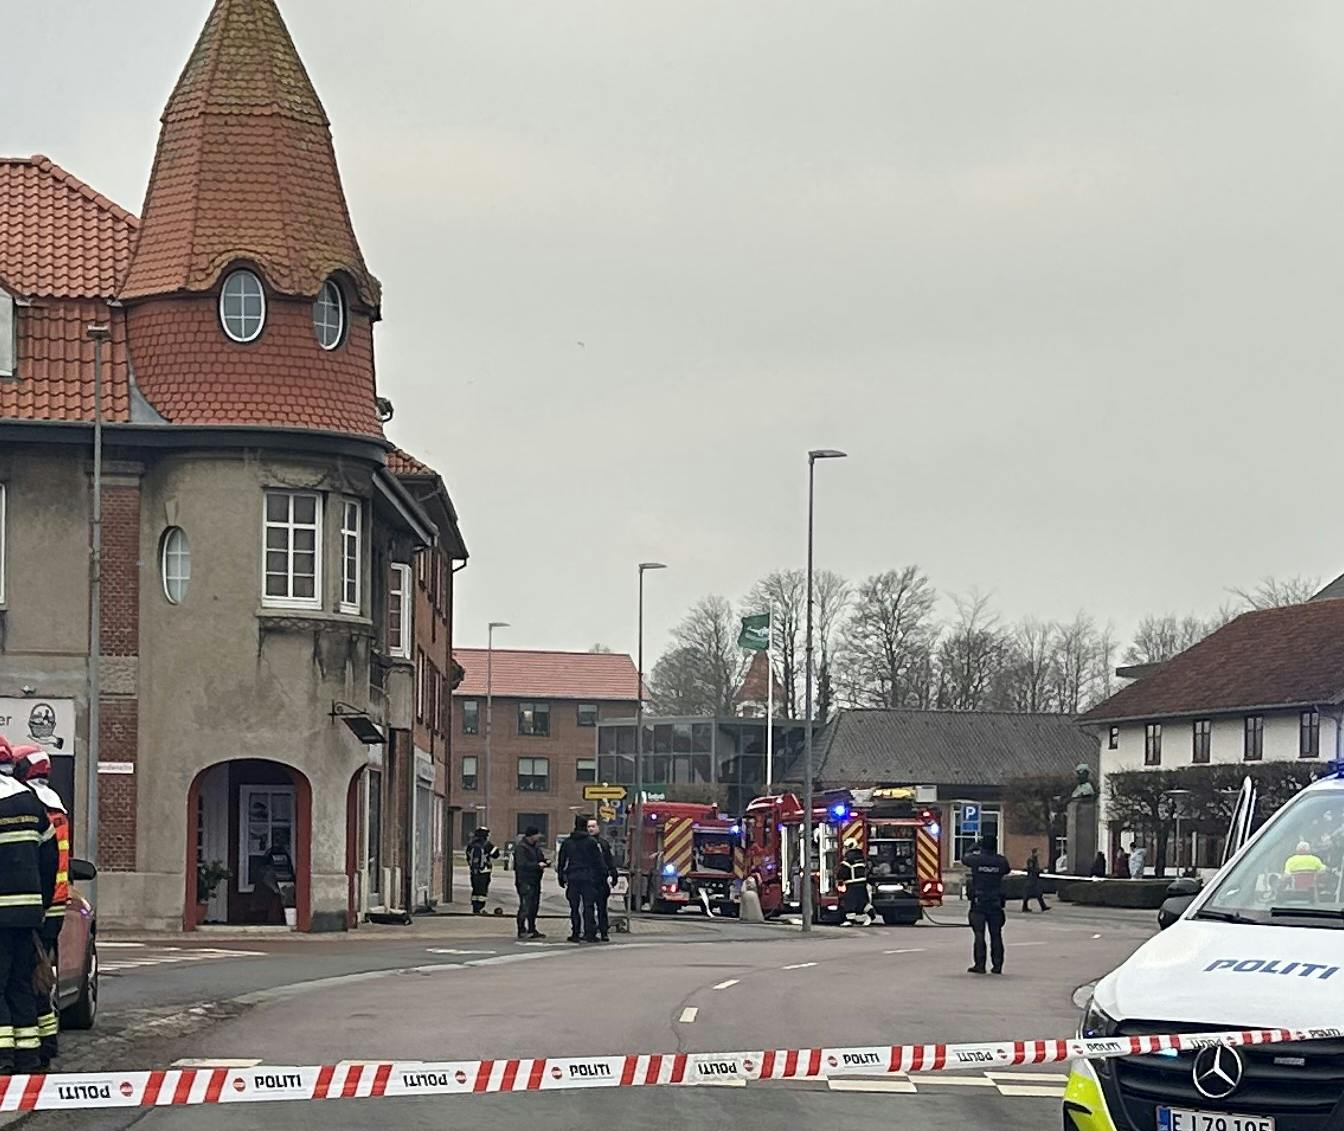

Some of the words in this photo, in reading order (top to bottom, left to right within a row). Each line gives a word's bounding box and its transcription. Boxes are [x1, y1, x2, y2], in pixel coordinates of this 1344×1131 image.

[966, 806, 976, 820] P
[1203, 959, 1341, 980] POLITI
[842, 1053, 880, 1065] POLITI
[957, 1051, 994, 1062] POLITI
[569, 1063, 611, 1076] POLITI
[697, 1062, 738, 1075] POLITI
[254, 1074, 302, 1089] POLITI
[403, 1073, 448, 1087] POLITI
[58, 1085, 111, 1100] POLITI
